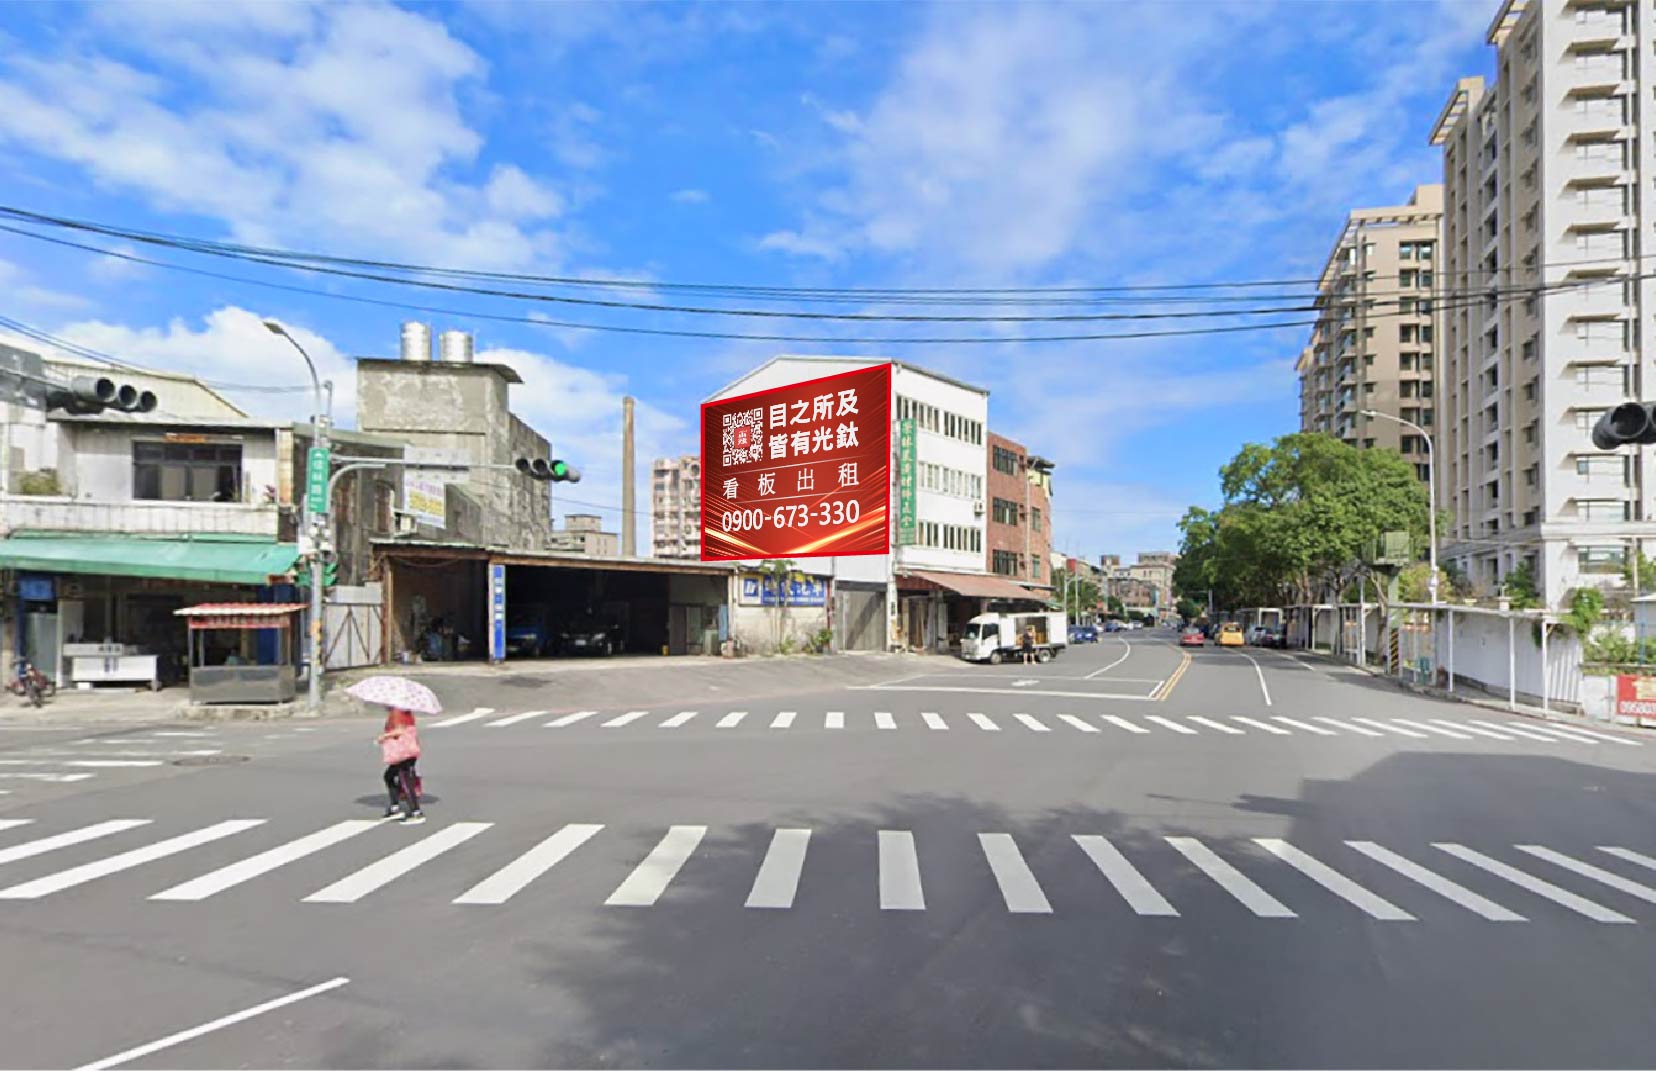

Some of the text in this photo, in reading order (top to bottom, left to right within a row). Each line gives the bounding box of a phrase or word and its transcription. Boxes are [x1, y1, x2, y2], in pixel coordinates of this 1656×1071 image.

[769, 388, 859, 430] 目之所及
[768, 420, 859, 460] 皆有光鈦
[722, 462, 860, 500] 看板出租
[722, 499, 860, 532] 0900-673-330
